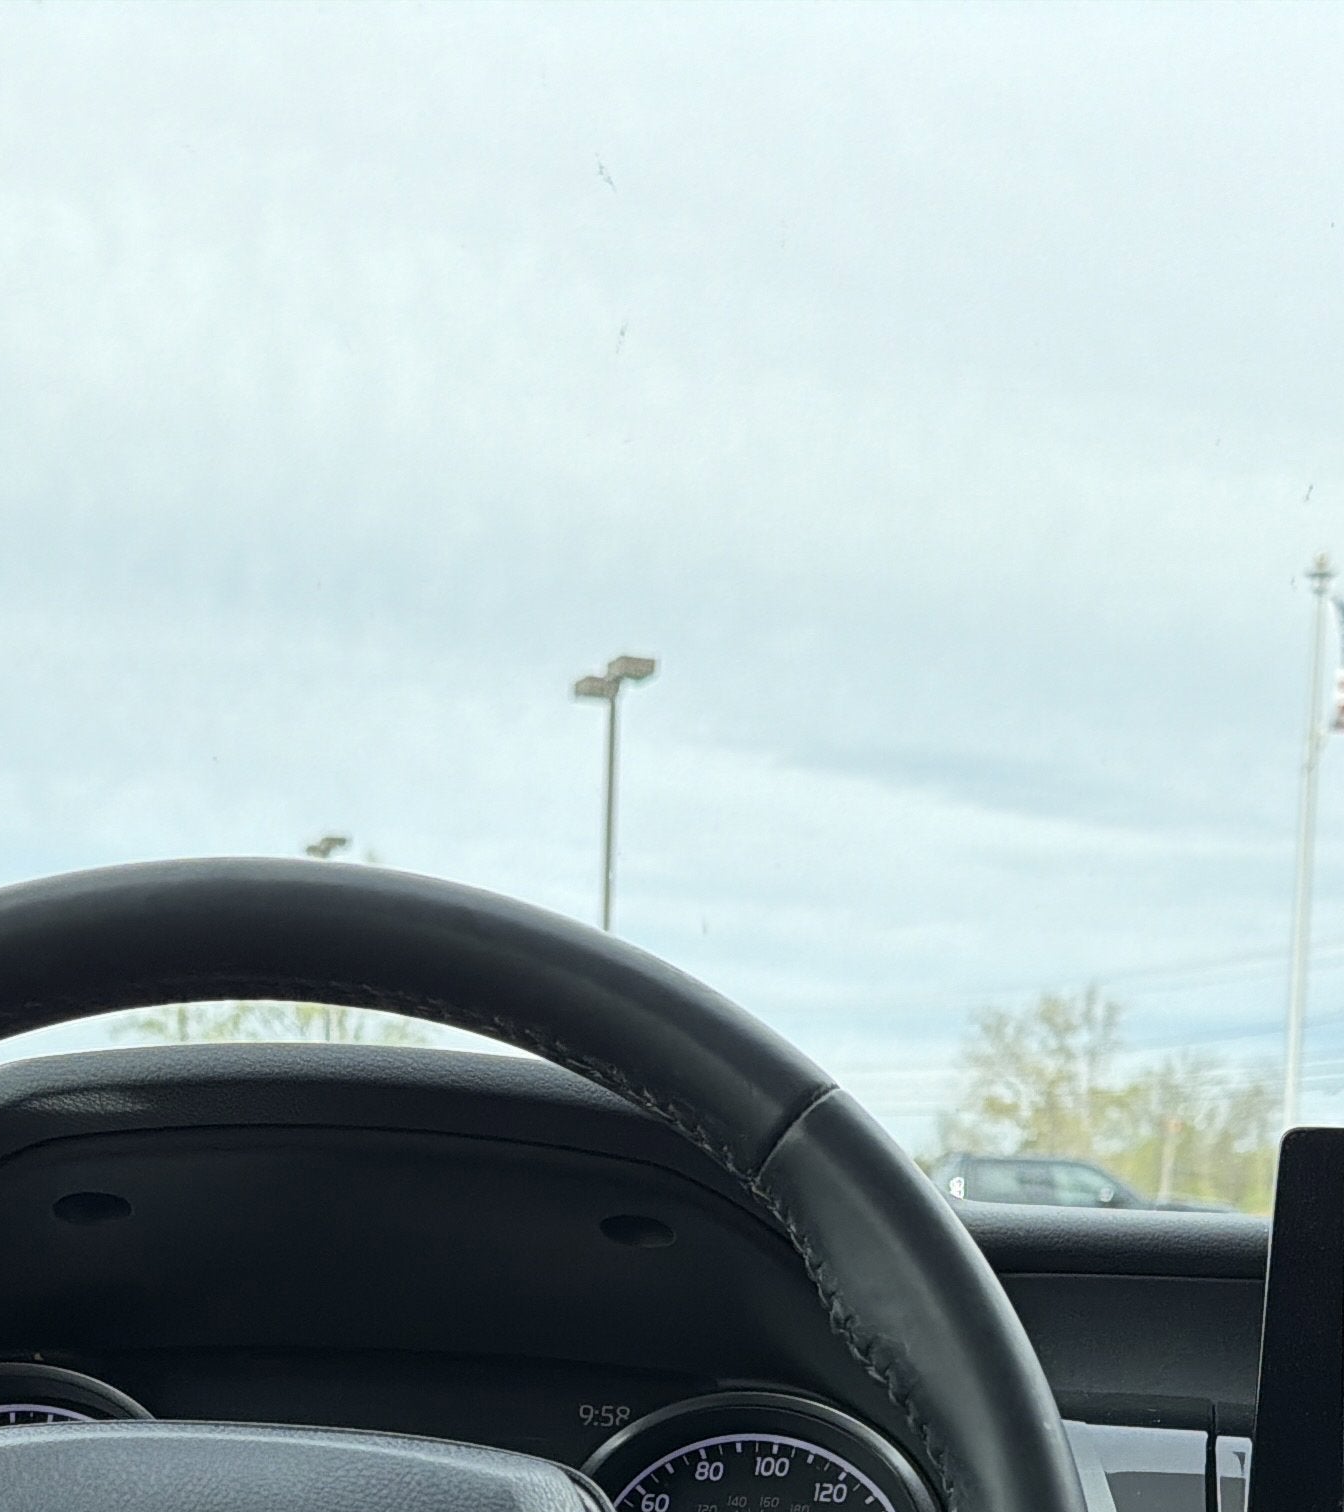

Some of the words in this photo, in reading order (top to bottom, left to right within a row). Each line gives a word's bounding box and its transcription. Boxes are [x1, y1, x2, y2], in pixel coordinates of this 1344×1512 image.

[579, 1403, 631, 1428] 9:58
[695, 1461, 724, 1482] 80
[755, 1456, 790, 1477] 100
[641, 1493, 670, 1512] 60
[728, 1496, 748, 1508] 140
[760, 1496, 780, 1508] 160
[814, 1483, 848, 1503] 120
